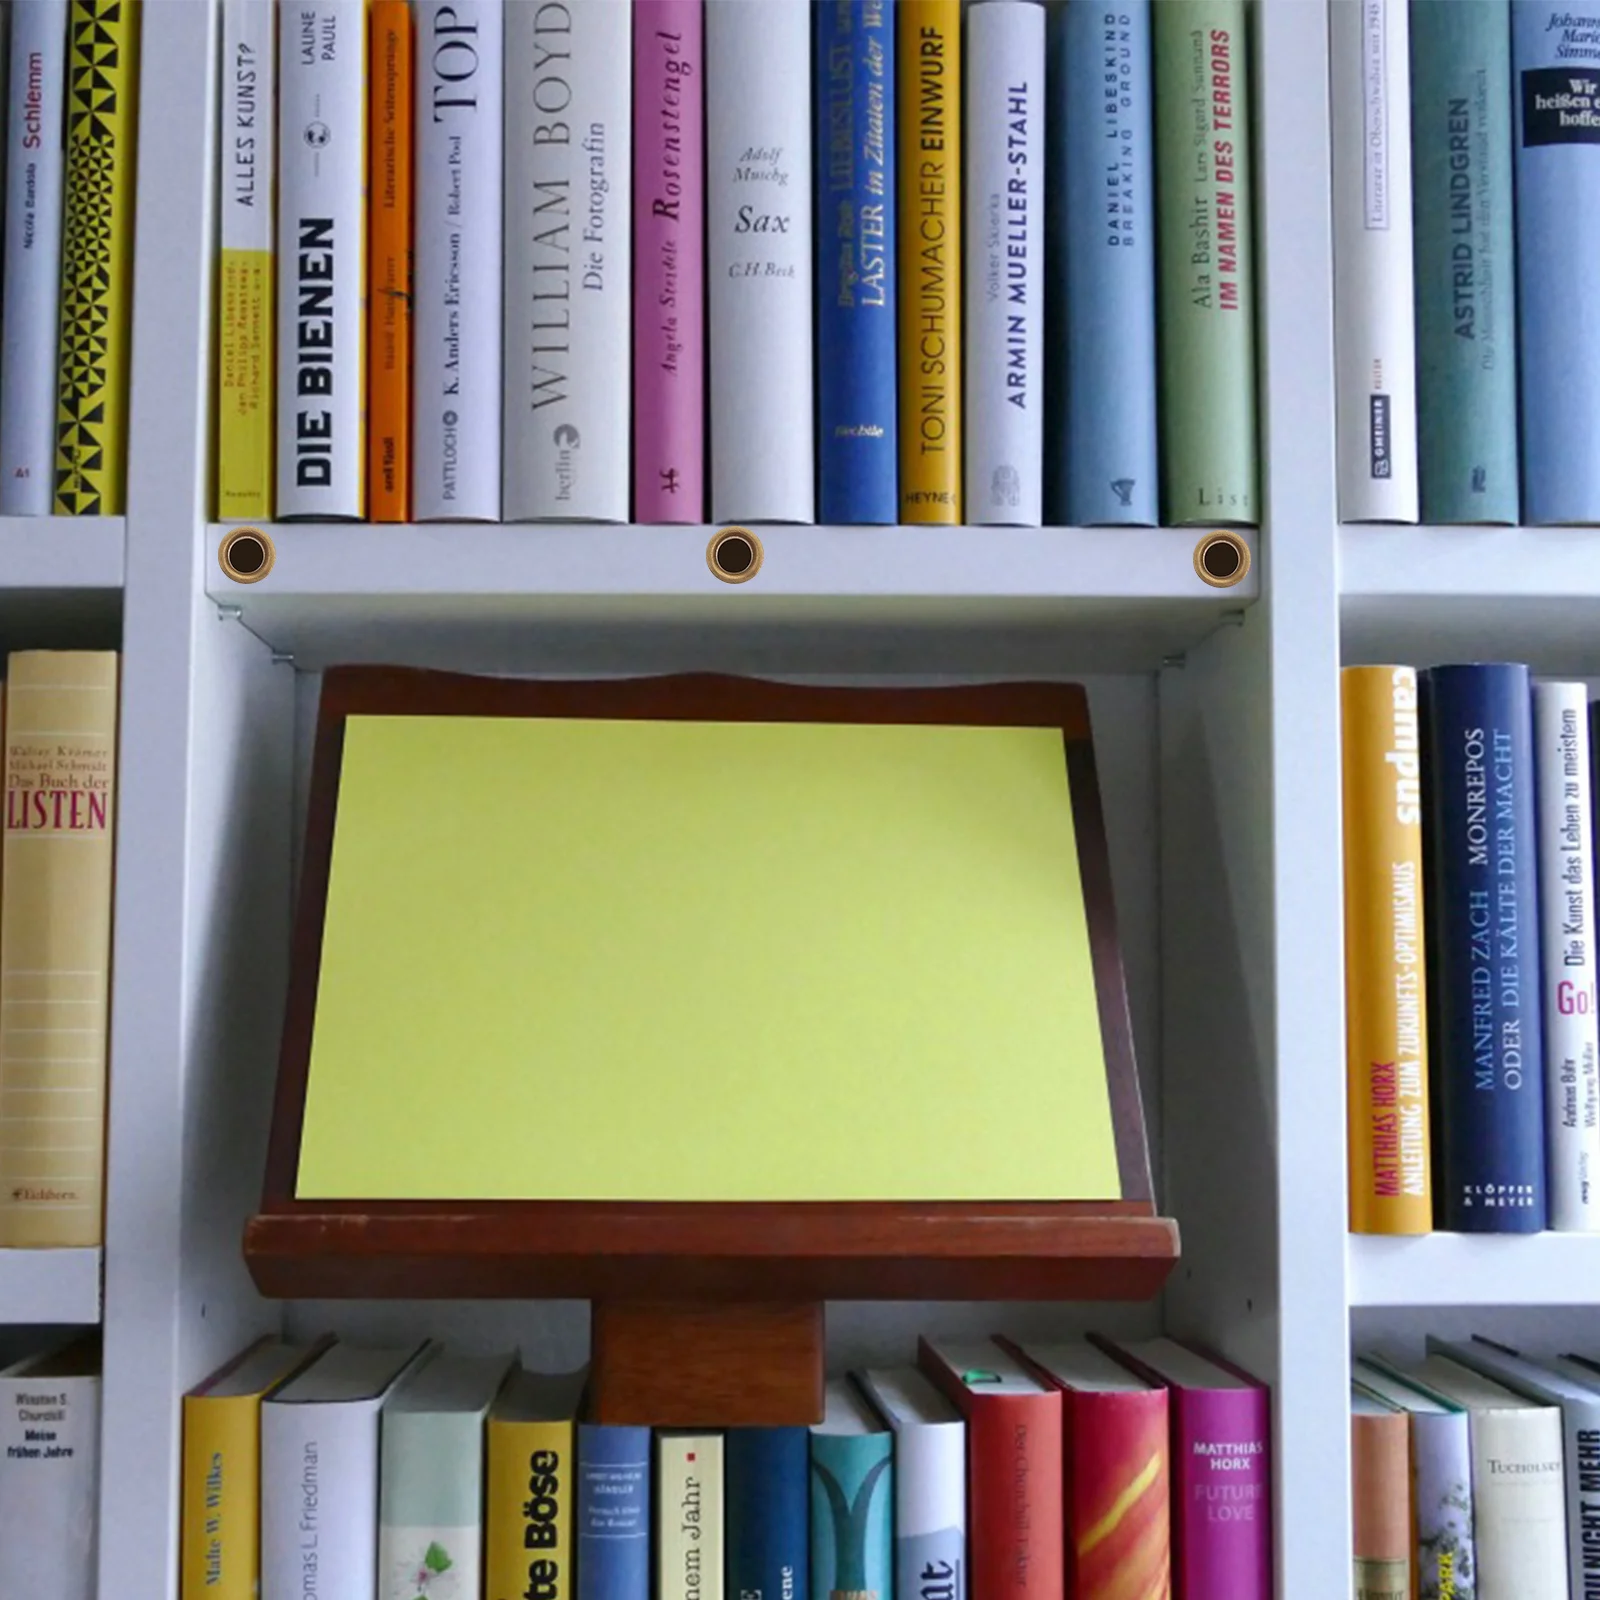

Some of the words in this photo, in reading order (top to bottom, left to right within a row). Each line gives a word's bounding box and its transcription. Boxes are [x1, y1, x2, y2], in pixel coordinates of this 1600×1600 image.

[321, 15, 337, 60] PAULL
[432, 5, 479, 123] TOP
[861, 36, 885, 77] der
[1119, 14, 1133, 107] GROUND
[22, 52, 43, 149] Schlemm
[236, 42, 257, 128] KUNST?
[533, 2, 573, 145] BOYD
[919, 26, 945, 151] EINWURF
[1104, 13, 1119, 139] LIBESKIND
[1210, 28, 1233, 131] TERRORS
[1535, 93, 1590, 110] heißen
[1568, 78, 1599, 95] Wir
[447, 135, 462, 164] Pool
[652, 31, 692, 221] Rosenstengel
[739, 146, 783, 166] Adolf
[862, 82, 885, 166] Zitaten
[235, 137, 255, 207] ALLES
[447, 169, 462, 215] Robert
[581, 123, 610, 242] Fotografin
[733, 167, 790, 187] Muschg
[864, 169, 885, 196] in
[1006, 82, 1028, 305] MUELLER-STAHL
[1121, 129, 1135, 247] BREAKING
[1192, 151, 1209, 183] Lars
[1213, 140, 1235, 184] DES
[1447, 98, 1472, 234] LINDGREN
[735, 204, 791, 234] Sax
[1106, 162, 1121, 247] DANIEL
[1189, 195, 1212, 265] Bashir
[1215, 191, 1237, 273] NAMEN
[443, 233, 460, 305] Ericsson
[582, 252, 605, 292] Die
[658, 240, 678, 308] Steidele
[860, 203, 885, 306] LASTER
[918, 161, 947, 375] SCHUMACHER
[986, 253, 1001, 302] Volker
[298, 218, 335, 397] BIENEN
[530, 180, 571, 411] WILLIAM
[1190, 273, 1212, 309] Ala
[1219, 281, 1238, 310] IM
[1451, 242, 1476, 341] ASTRID
[443, 311, 460, 371] Anders
[659, 317, 682, 377] Angela
[1007, 315, 1027, 410] ARMIN
[443, 377, 460, 396] K.
[297, 411, 332, 487] DIE
[919, 386, 946, 456] TONI
[443, 428, 459, 500] PATTLOCH
[555, 449, 577, 501] berlin
[1384, 666, 1420, 825] campus
[1492, 728, 1515, 819] MACHT
[7, 789, 108, 829] LISTEN
[9, 773, 34, 789] Das
[39, 772, 79, 789] Buch
[82, 773, 109, 789] der
[1464, 727, 1489, 866] MONREPOS
[1563, 782, 1580, 800] zu
[1497, 827, 1517, 875] DER
[1559, 803, 1582, 852] Leben
[1561, 856, 1583, 885] das
[1469, 890, 1492, 961] ZACH
[1494, 881, 1518, 959] KÄLTE
[1562, 889, 1585, 935] Kunst
[1500, 964, 1521, 1008] DIE
[1562, 939, 1586, 967] Die
[1471, 966, 1495, 1091] MANFRED
[1502, 1018, 1523, 1091] ODER
[1370, 1061, 1396, 1109] HORX
[1397, 1060, 1421, 1098] ZUM
[1372, 1114, 1399, 1197] MATTHIAS
[1399, 1104, 1425, 1197] ANLEITUNG
[205, 1452, 223, 1510] Wilkes
[1193, 1441, 1263, 1455] MATTHIAS
[1210, 1457, 1251, 1471] HORX
[1576, 1429, 1600, 1493] MEHR
[298, 1441, 319, 1532] Friedman
[522, 1450, 560, 1550] Böse
[680, 1476, 702, 1541] Jahr
[1207, 1505, 1255, 1521] LOVE
[205, 1514, 222, 1534] W.
[1578, 1500, 1600, 1569] NICHT
[205, 1539, 222, 1586] Malte
